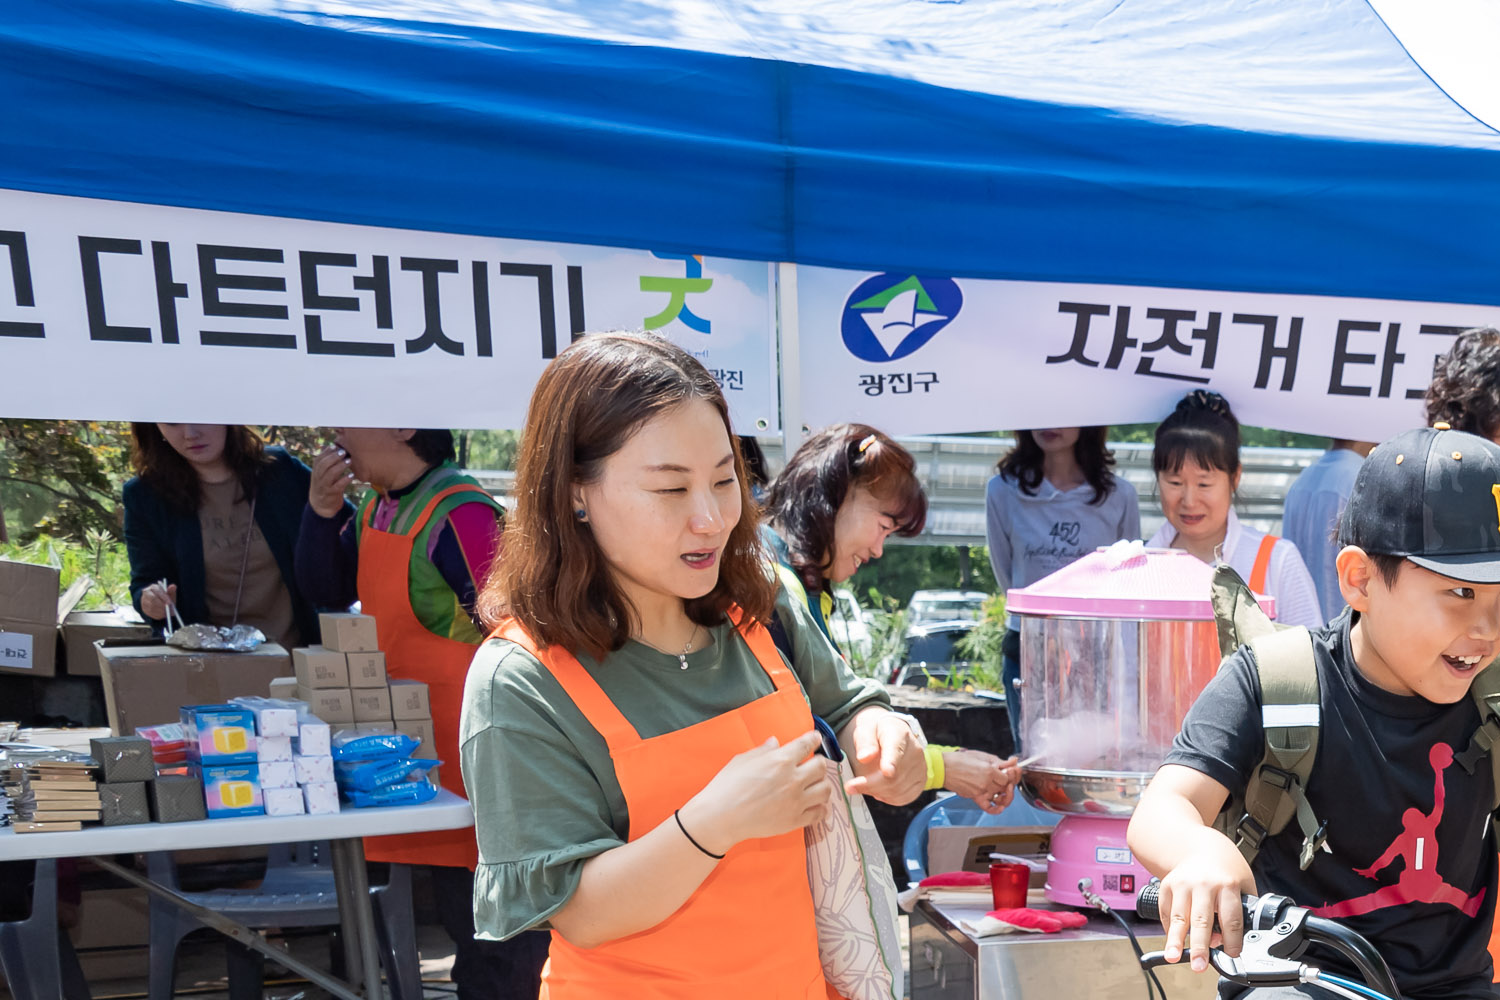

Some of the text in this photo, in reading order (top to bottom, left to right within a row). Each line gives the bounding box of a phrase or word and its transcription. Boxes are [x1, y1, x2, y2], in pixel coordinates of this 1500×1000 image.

[77, 235, 586, 360] 다트던지기
[1045, 301, 1304, 392] 자전거
[858, 372, 940, 396] 광진구
[1048, 521, 1081, 546] 452
